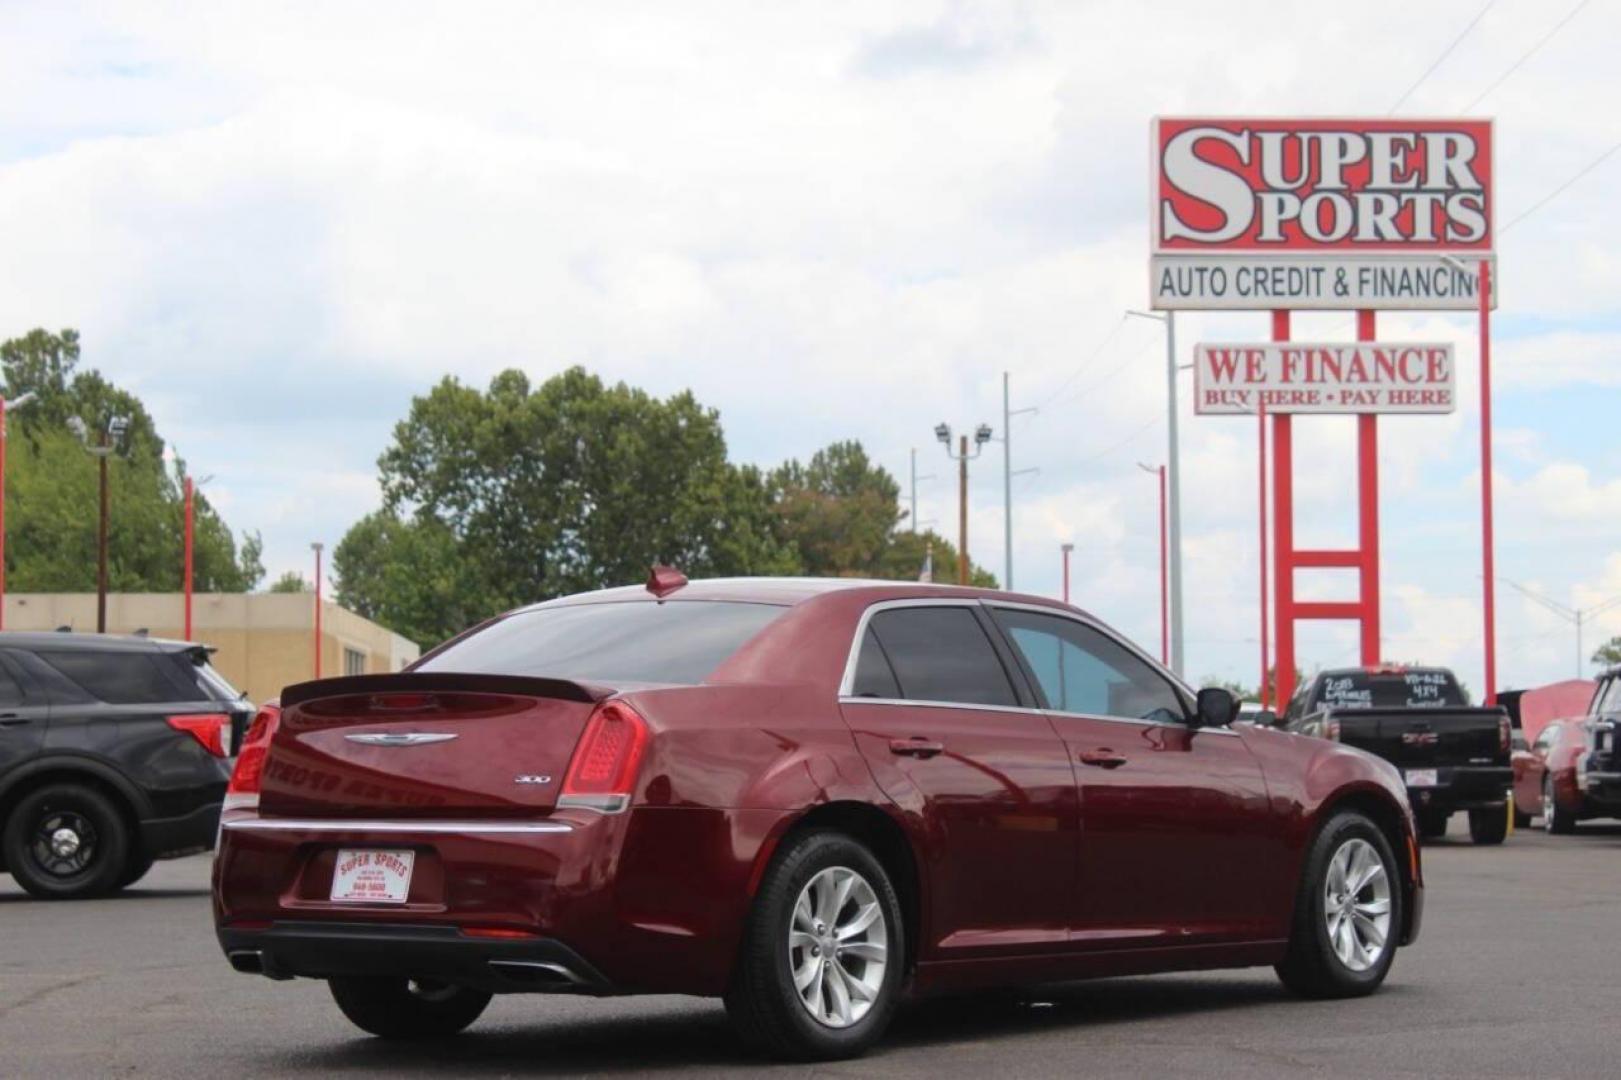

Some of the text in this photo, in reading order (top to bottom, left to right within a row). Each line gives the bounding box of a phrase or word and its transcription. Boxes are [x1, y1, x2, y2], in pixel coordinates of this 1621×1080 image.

[1163, 127, 1484, 242] SUPER
[1159, 266, 1227, 297] AUTO
[1236, 266, 1325, 297] CREDIT
[1334, 267, 1349, 297] &
[1205, 348, 1449, 384] WE FINANCE
[1205, 389, 1451, 405] BUY HERE PAY HERE
[514, 771, 552, 784] 300
[340, 851, 407, 877] SUPER SPORTS
